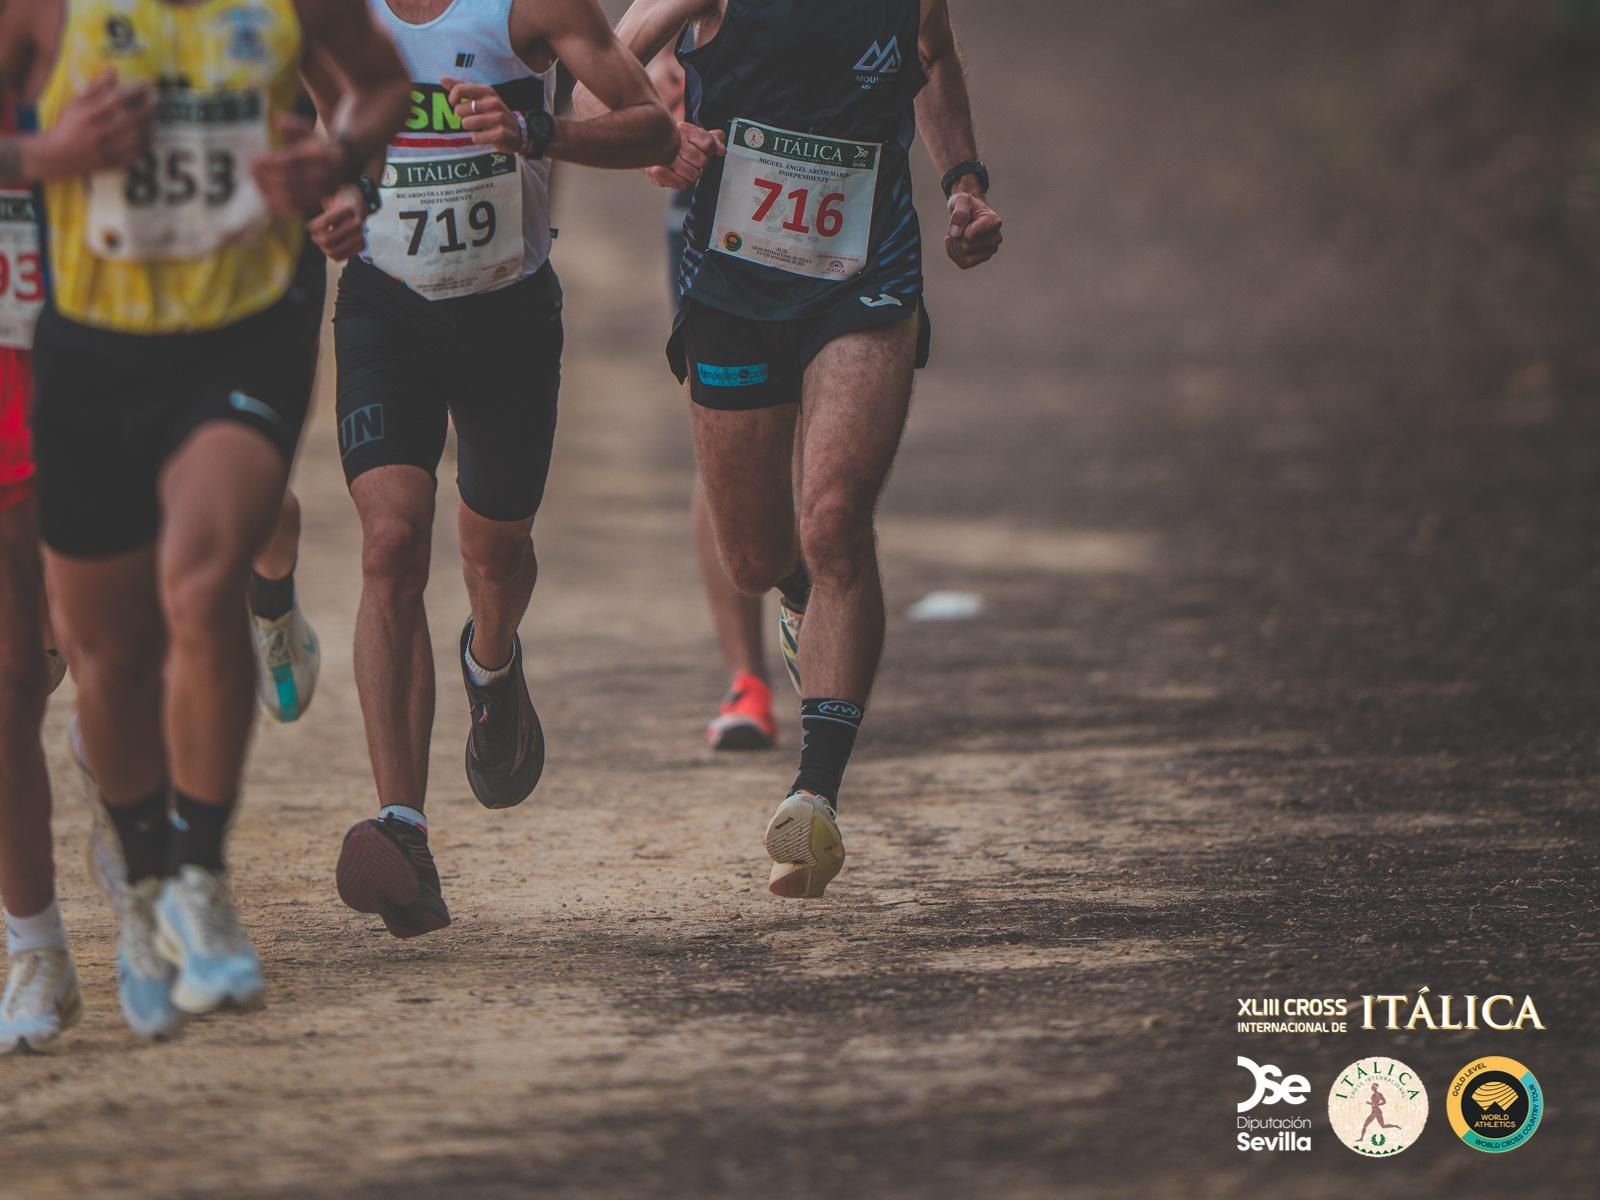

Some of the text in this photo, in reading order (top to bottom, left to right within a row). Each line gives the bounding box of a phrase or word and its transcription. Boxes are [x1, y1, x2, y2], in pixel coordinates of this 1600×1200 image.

[773, 137, 843, 162] ITÁLICA
[125, 151, 236, 206] 853
[407, 162, 480, 183] ITÁLICA
[752, 178, 845, 237] 716
[399, 201, 496, 256] 719
[822, 704, 857, 716] NW
